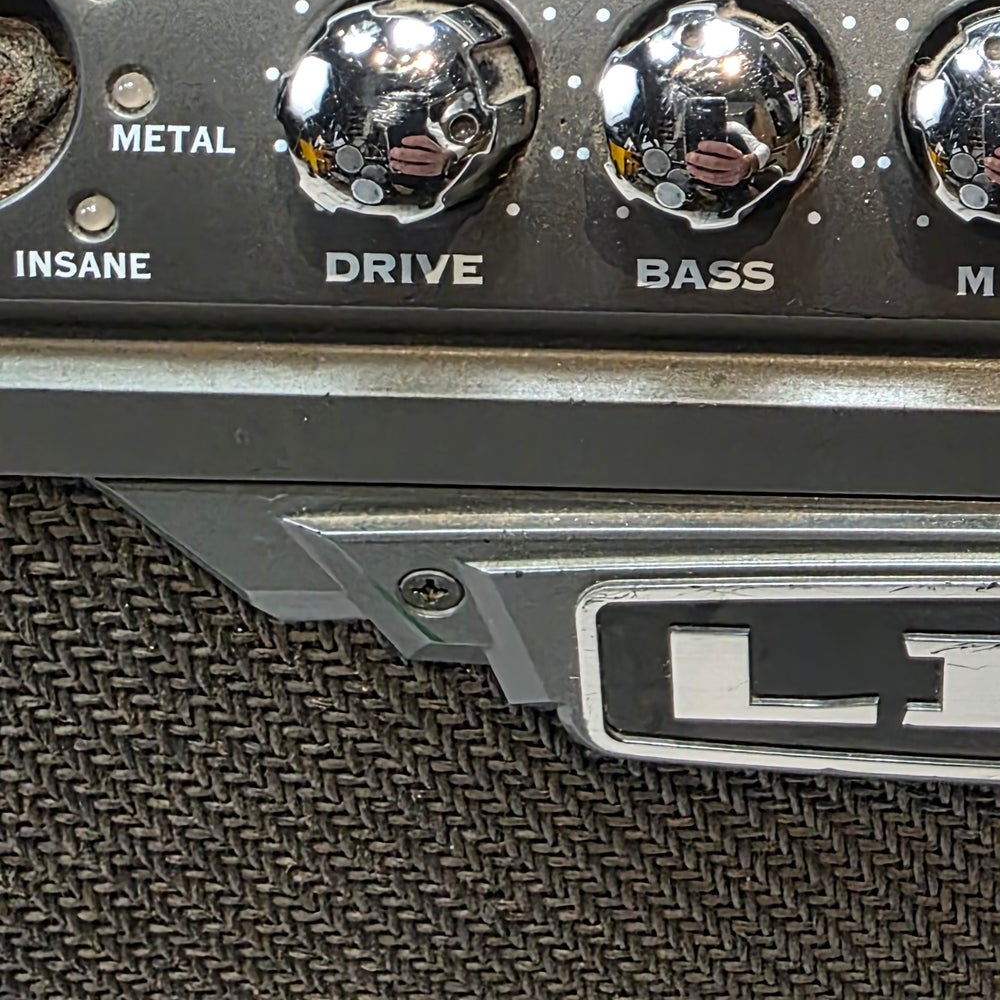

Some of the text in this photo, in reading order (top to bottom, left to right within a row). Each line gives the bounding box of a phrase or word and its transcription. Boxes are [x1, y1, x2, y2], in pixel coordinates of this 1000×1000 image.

[111, 123, 237, 155] METAL
[14, 250, 152, 281] INSANE
[324, 251, 484, 286] DRIVE
[636, 258, 775, 291] BASS
